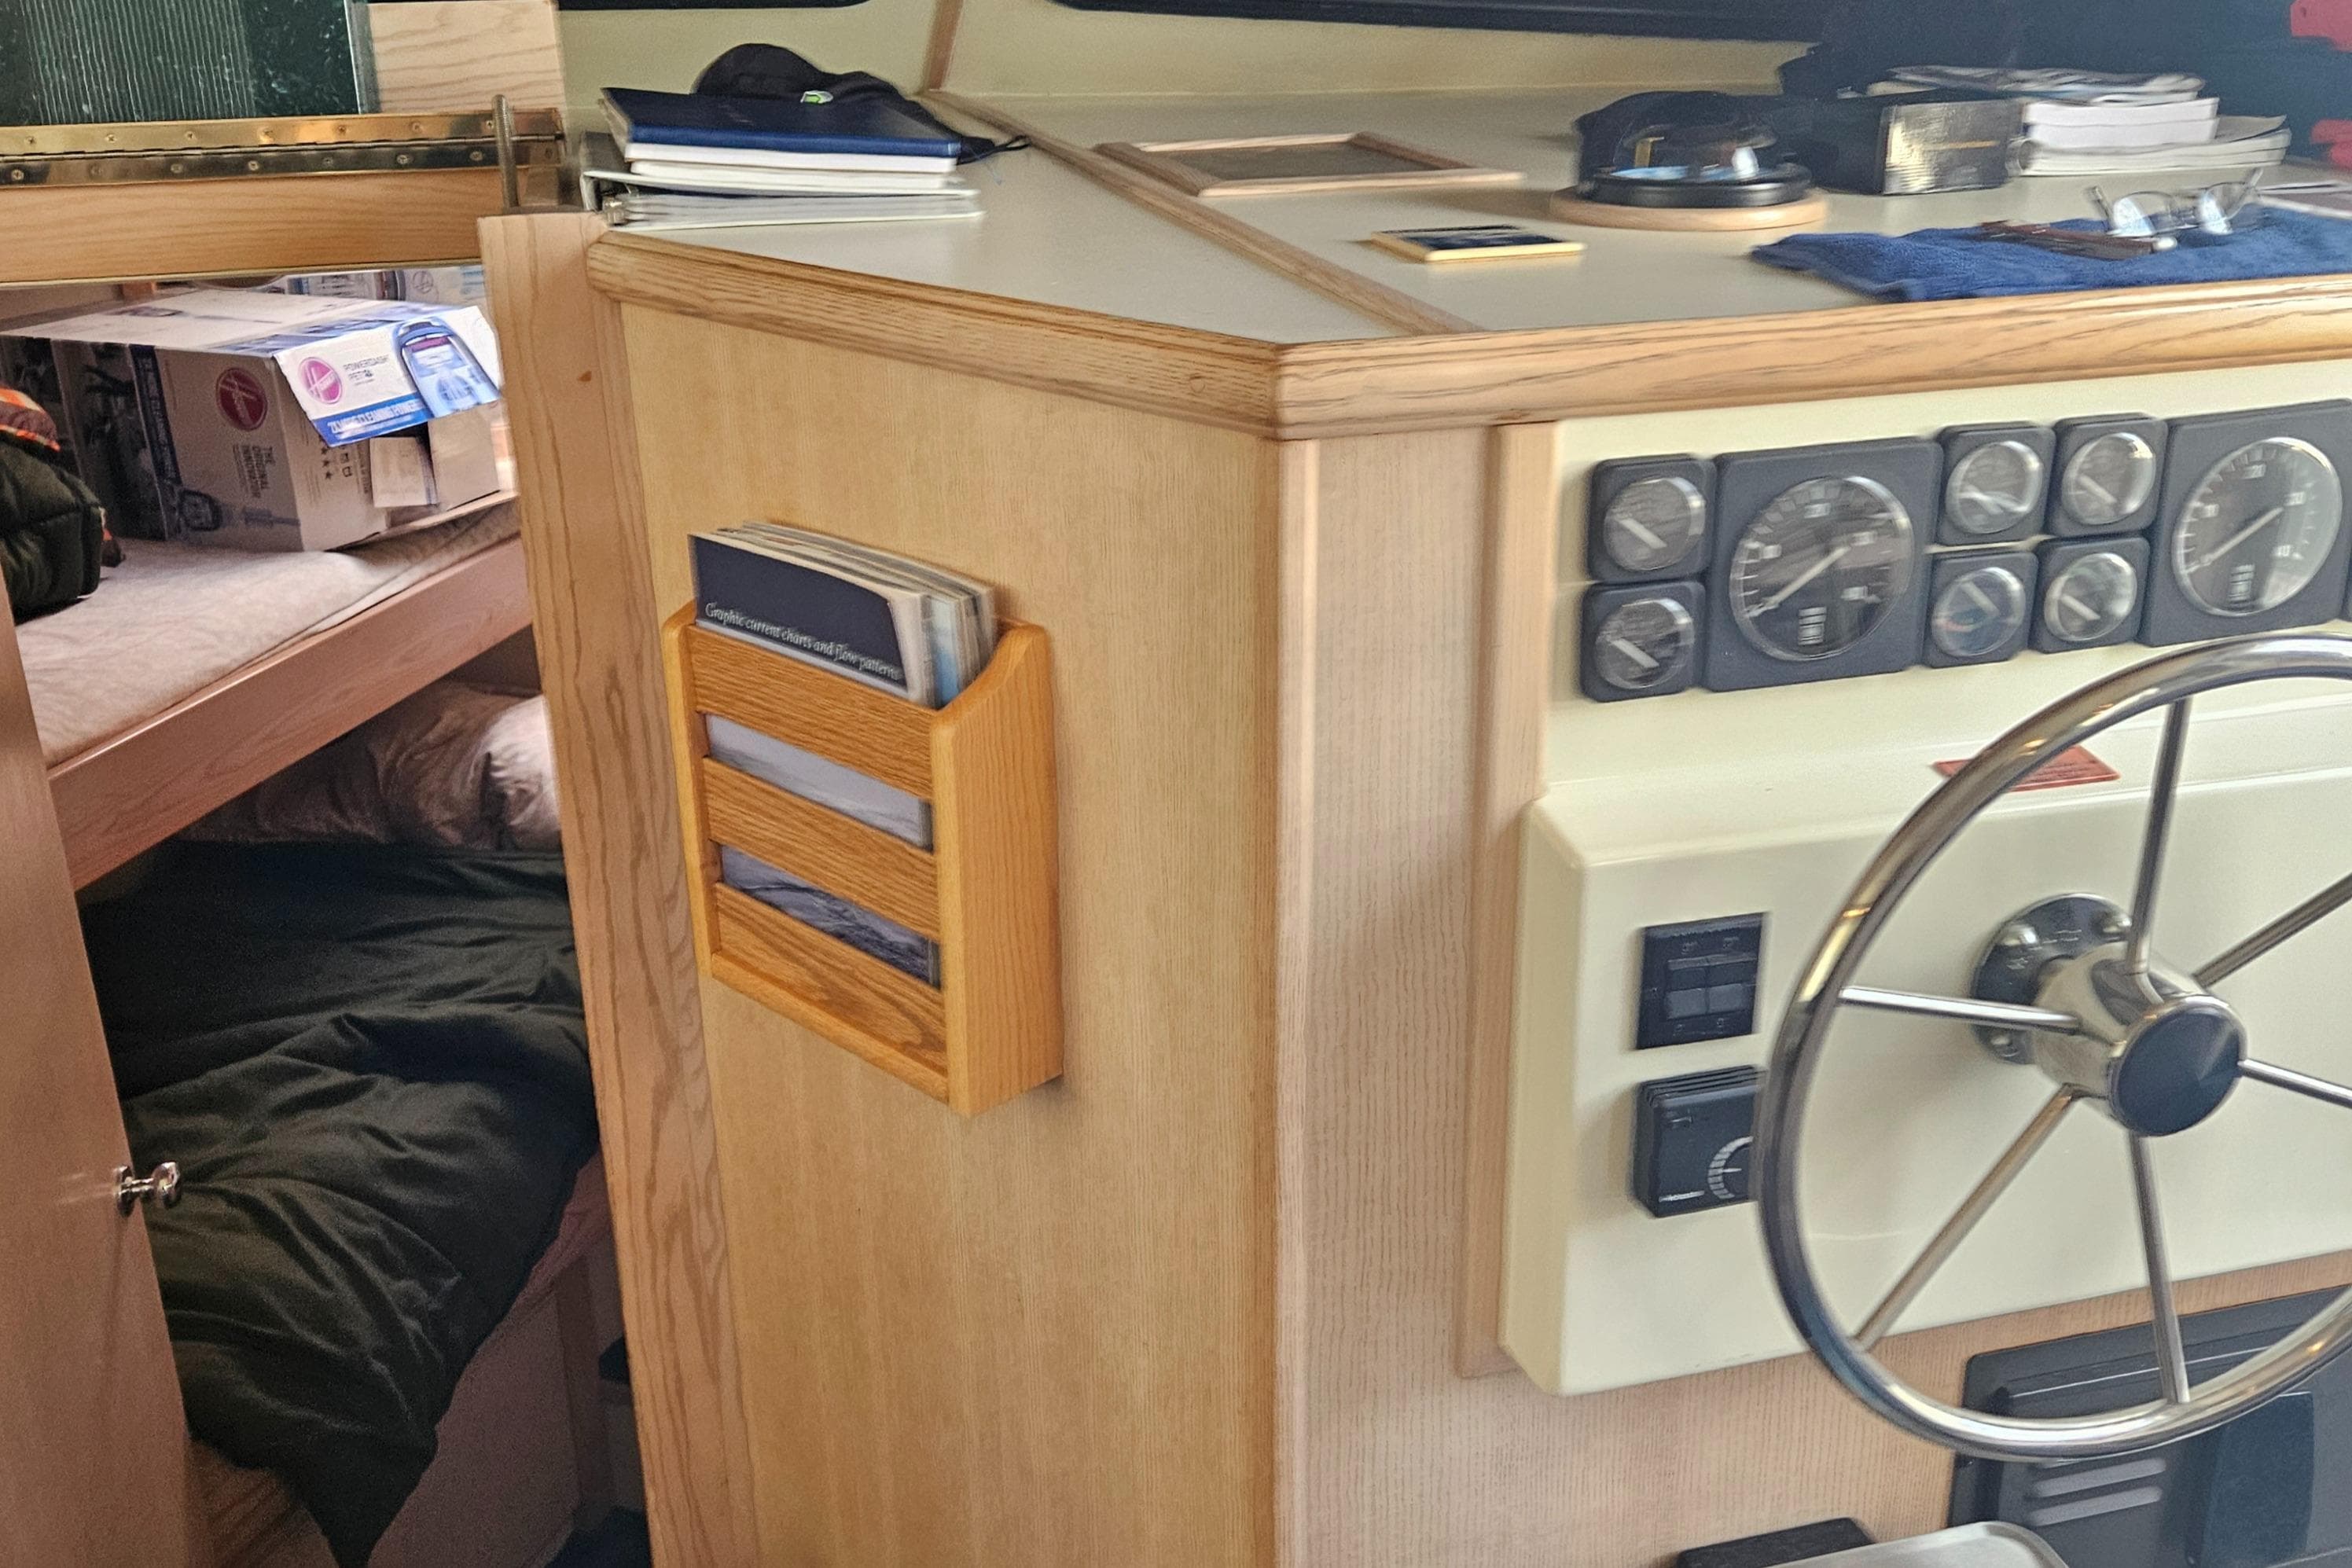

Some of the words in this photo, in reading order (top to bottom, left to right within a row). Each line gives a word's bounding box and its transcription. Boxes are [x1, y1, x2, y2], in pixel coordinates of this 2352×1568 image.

[705, 601, 745, 626] Graphic
[744, 615, 781, 639] current
[781, 626, 813, 649] charts
[813, 640, 834, 656] and
[832, 643, 859, 663] flow
